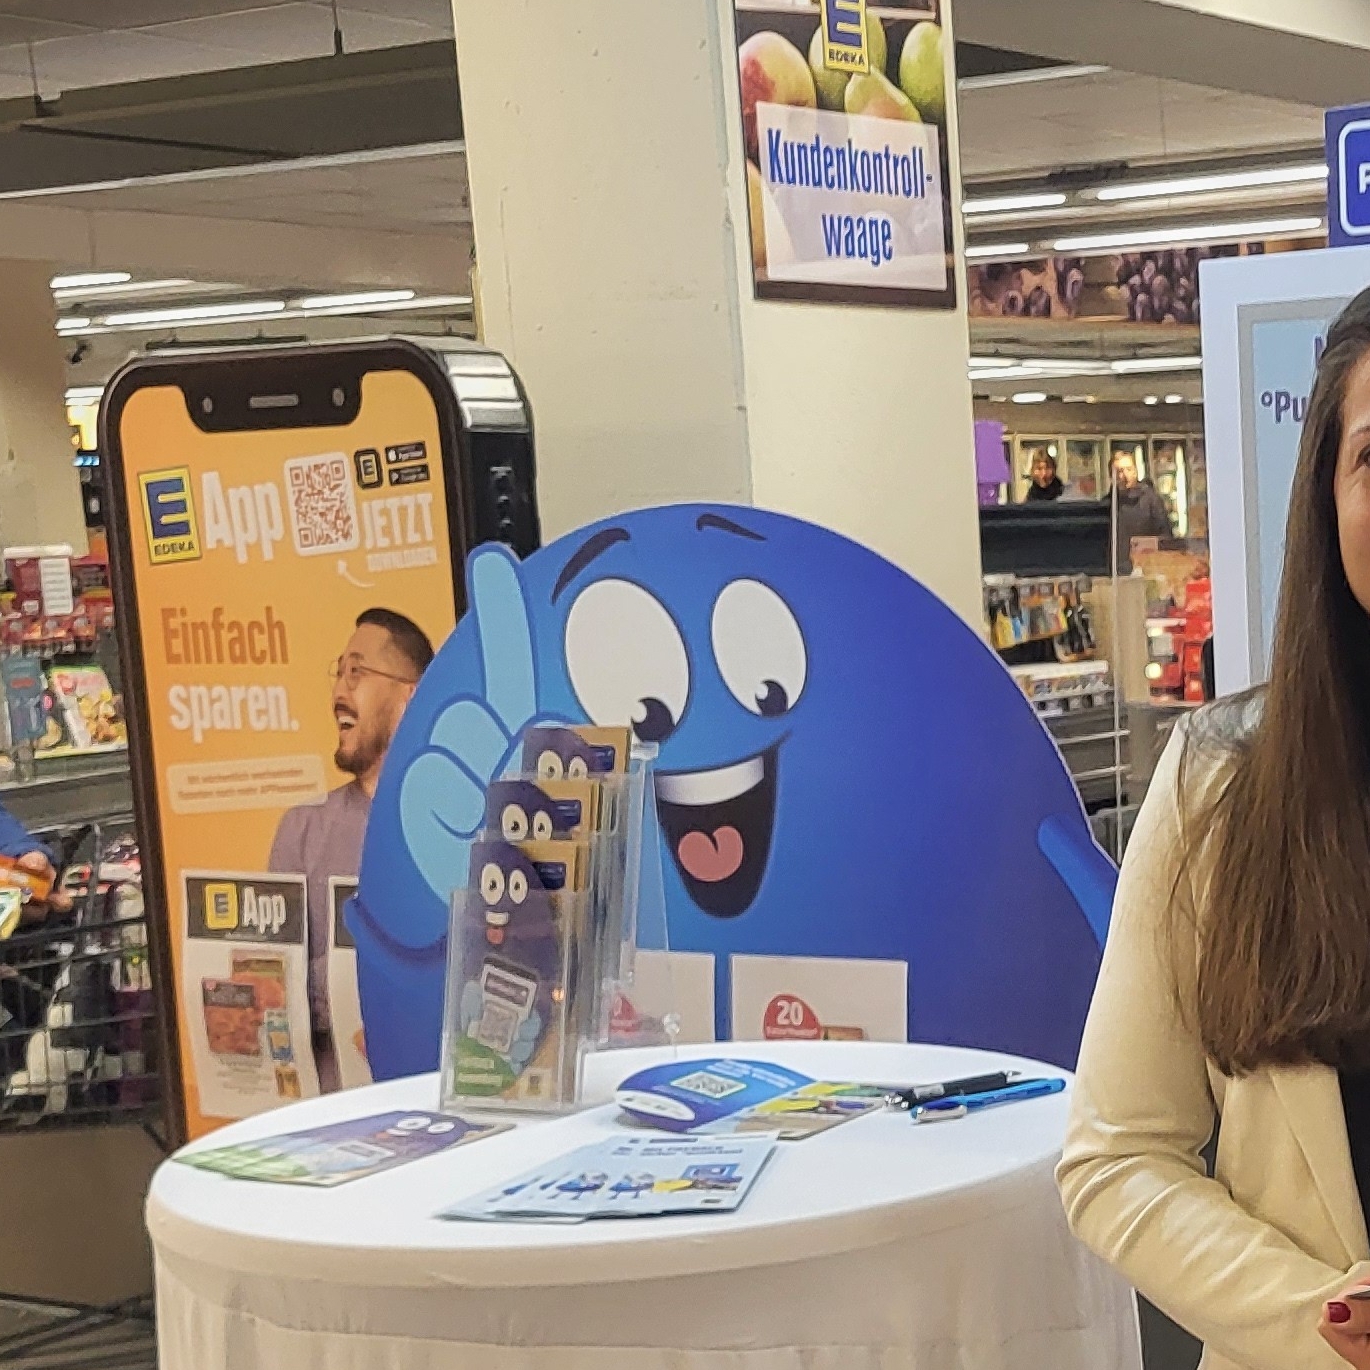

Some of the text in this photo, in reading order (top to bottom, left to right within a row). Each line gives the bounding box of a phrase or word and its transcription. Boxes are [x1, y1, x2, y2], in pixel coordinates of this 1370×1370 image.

[767, 128, 933, 199] Kundenkontroll-
[821, 213, 894, 267] waage
[145, 470, 286, 565] E App
[362, 493, 433, 550] JETZT
[153, 541, 196, 558] EDEKA
[161, 605, 289, 666] Einfach
[168, 683, 300, 744] sparen.
[243, 886, 287, 935] App
[776, 1001, 804, 1027] 20
